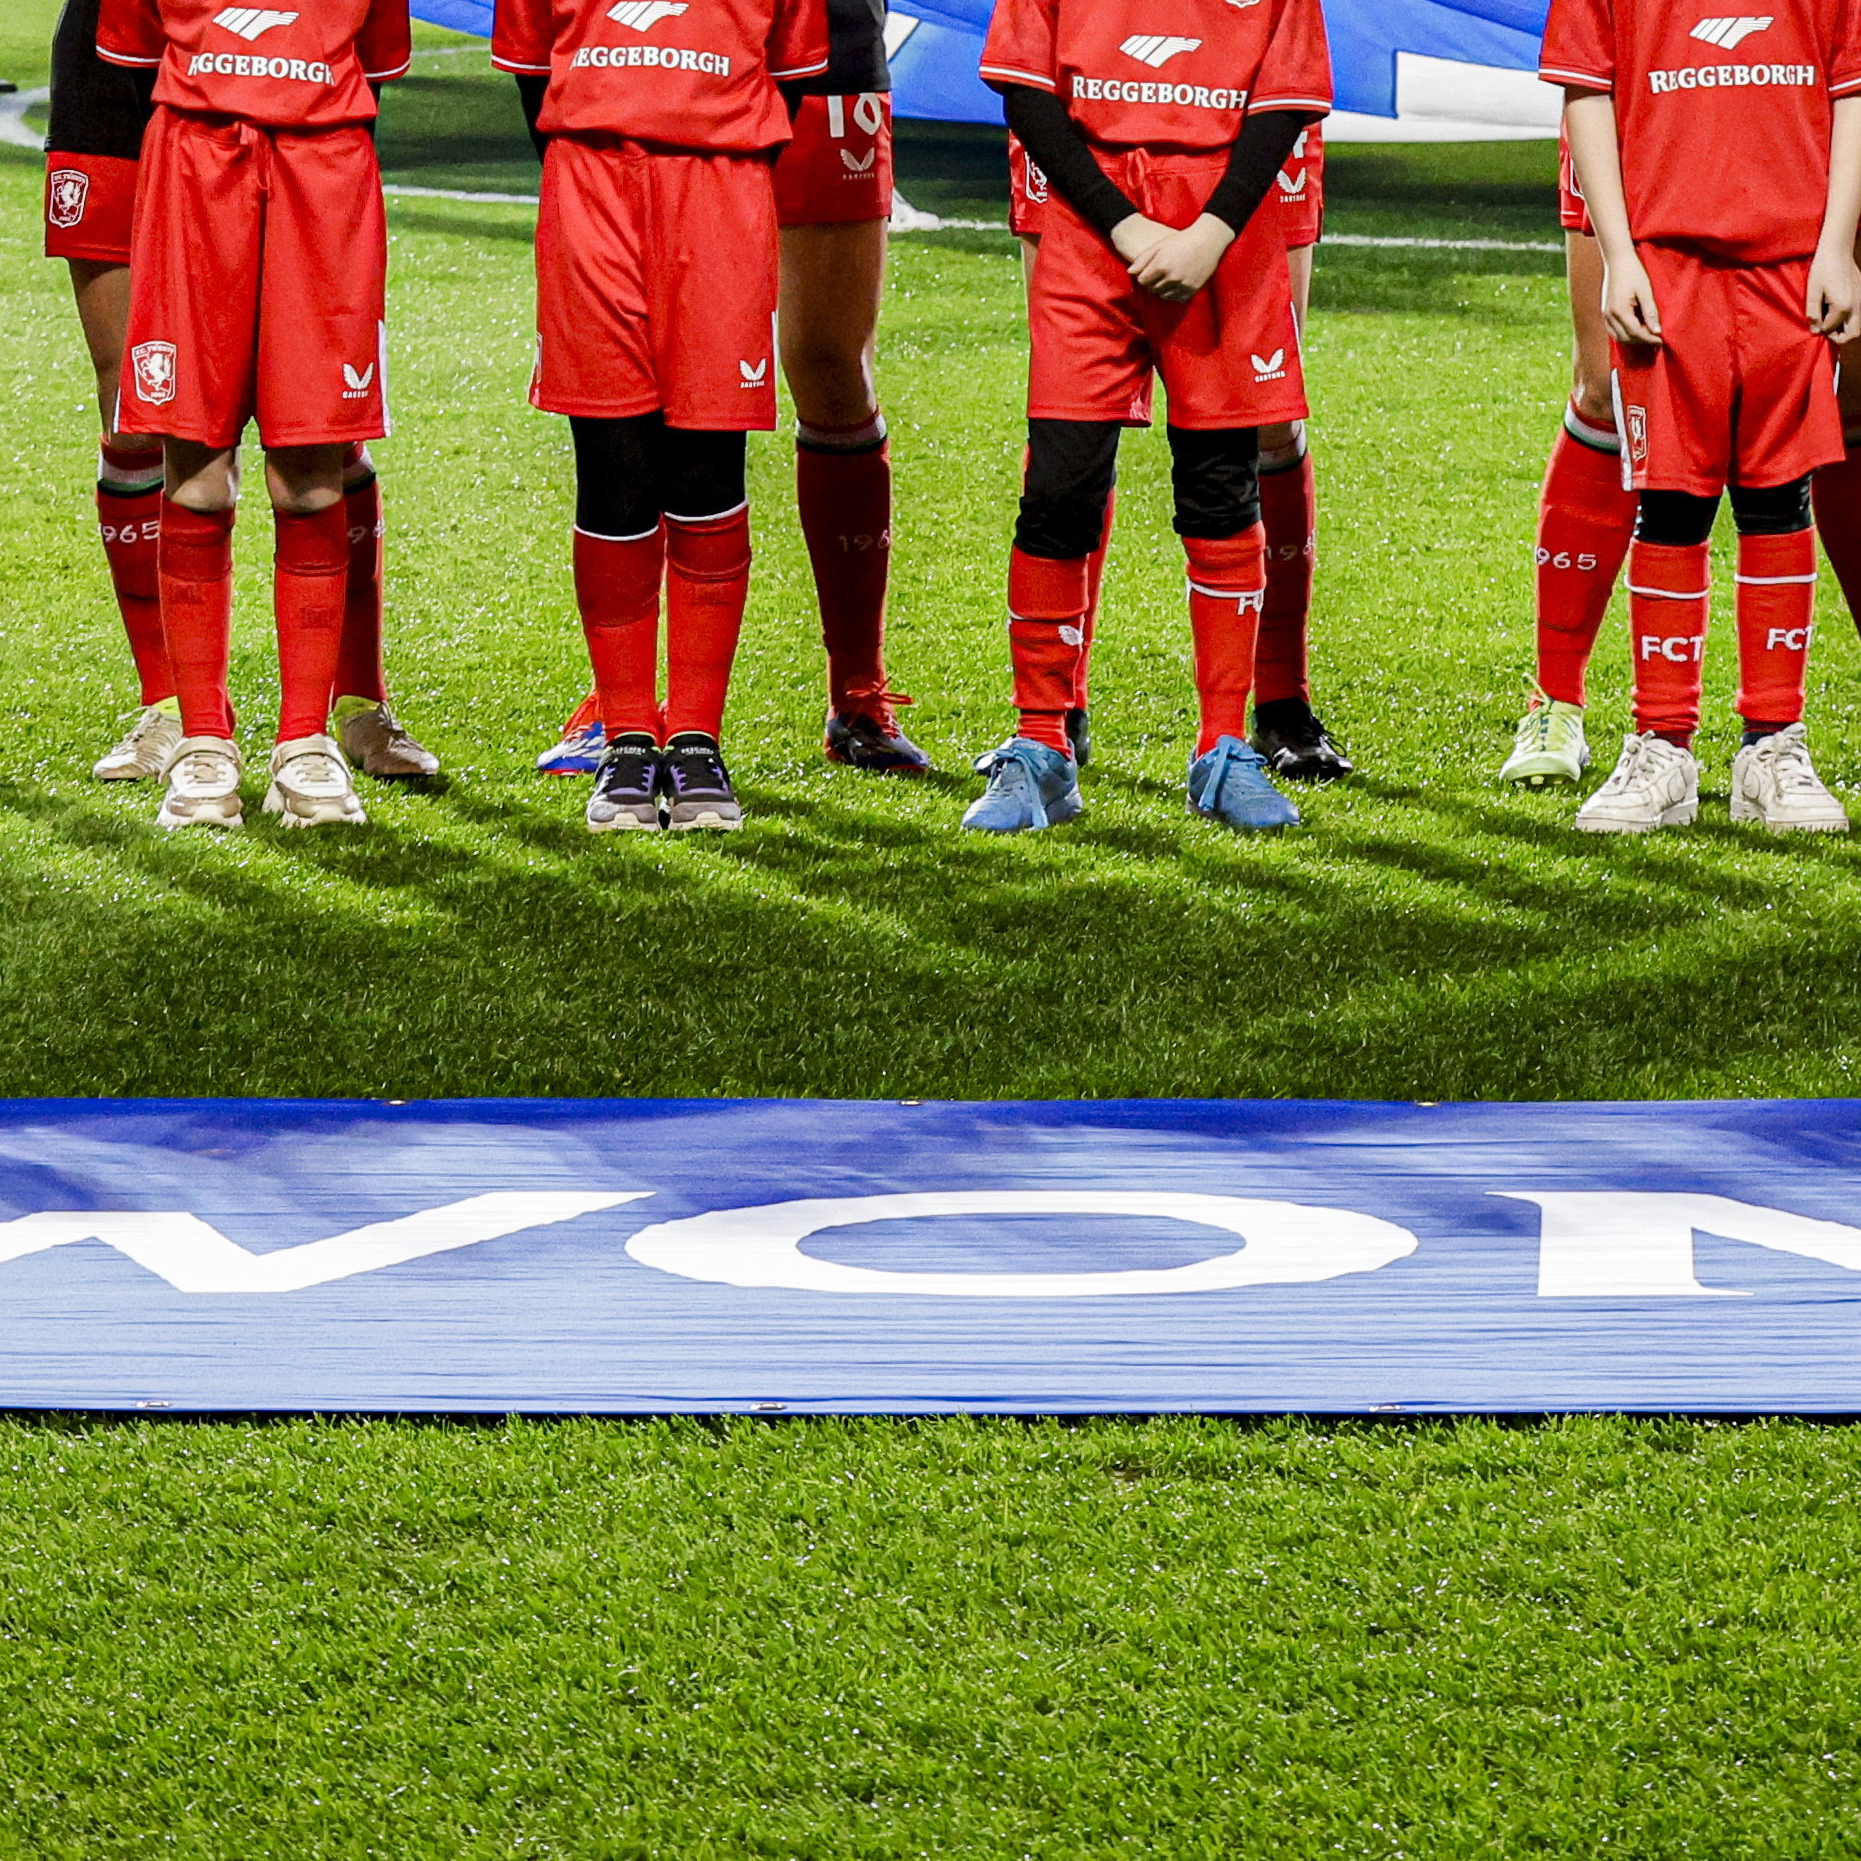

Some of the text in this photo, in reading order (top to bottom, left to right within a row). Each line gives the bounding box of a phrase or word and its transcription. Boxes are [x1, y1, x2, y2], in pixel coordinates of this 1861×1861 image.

[569, 46, 730, 77] EGGEBORGH
[1072, 75, 1248, 109] REGGEBORGH
[1647, 64, 1814, 94] REGGEBORGH
[1641, 635, 1703, 662] FCT
